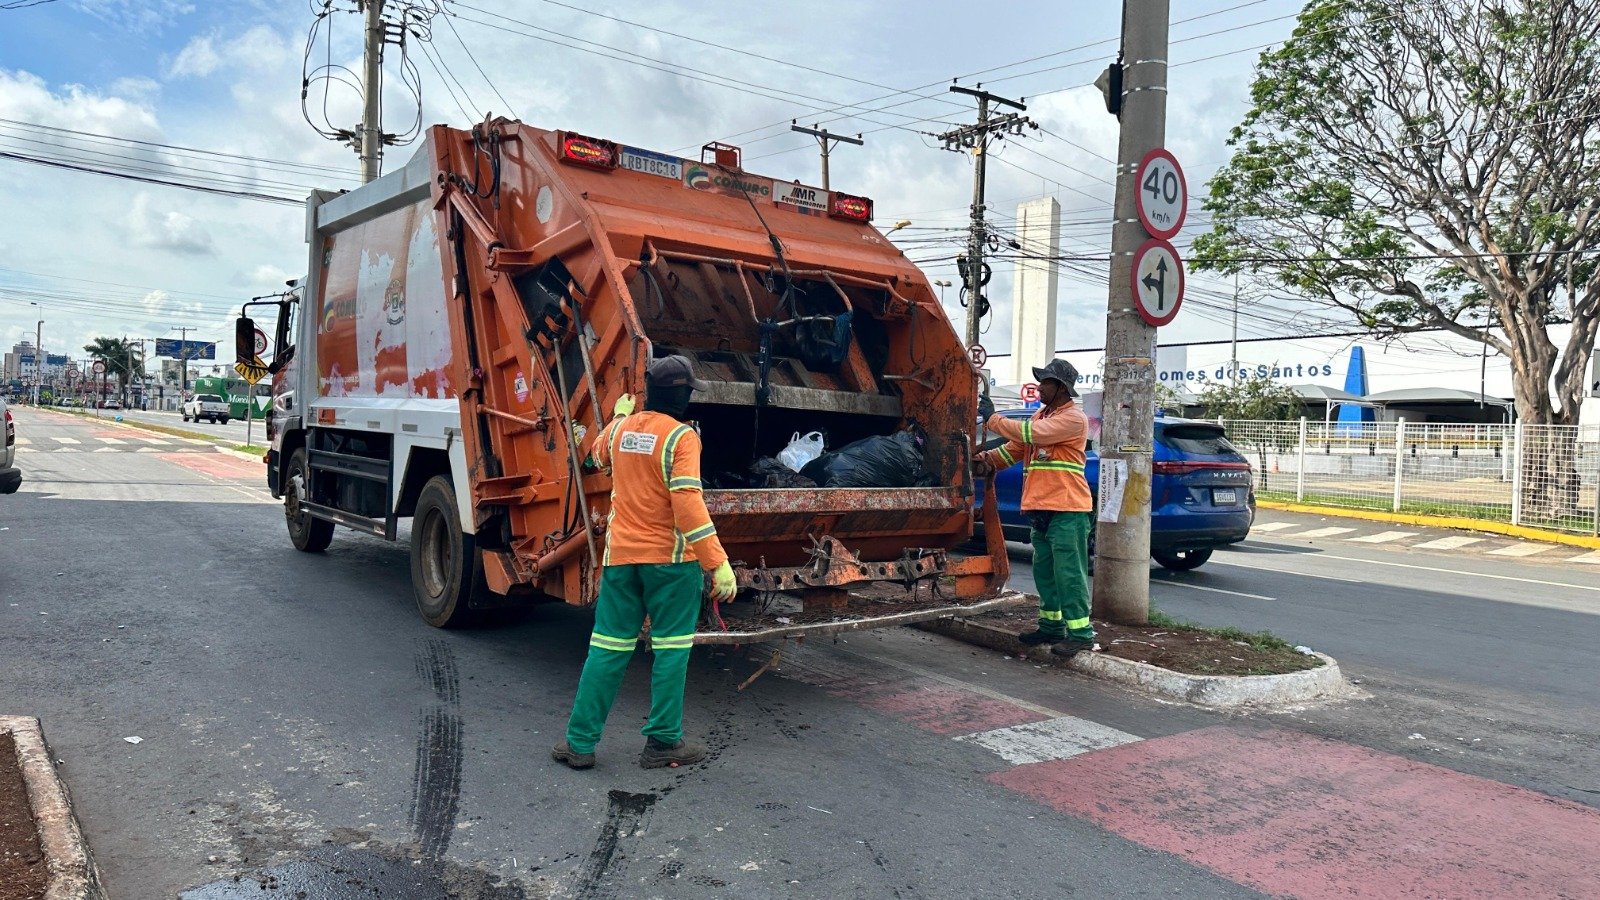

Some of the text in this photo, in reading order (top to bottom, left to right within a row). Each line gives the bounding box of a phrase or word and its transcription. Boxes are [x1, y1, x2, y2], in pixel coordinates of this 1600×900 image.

[713, 175, 770, 196] COMURG
[1143, 167, 1178, 204] 40
[781, 195, 827, 209] Equipamentos
[1152, 210, 1171, 223] km/h
[1160, 369, 1206, 381] omes
[1215, 366, 1247, 380] dos
[1257, 363, 1332, 378] Santos
[227, 394, 256, 404] Moreia
